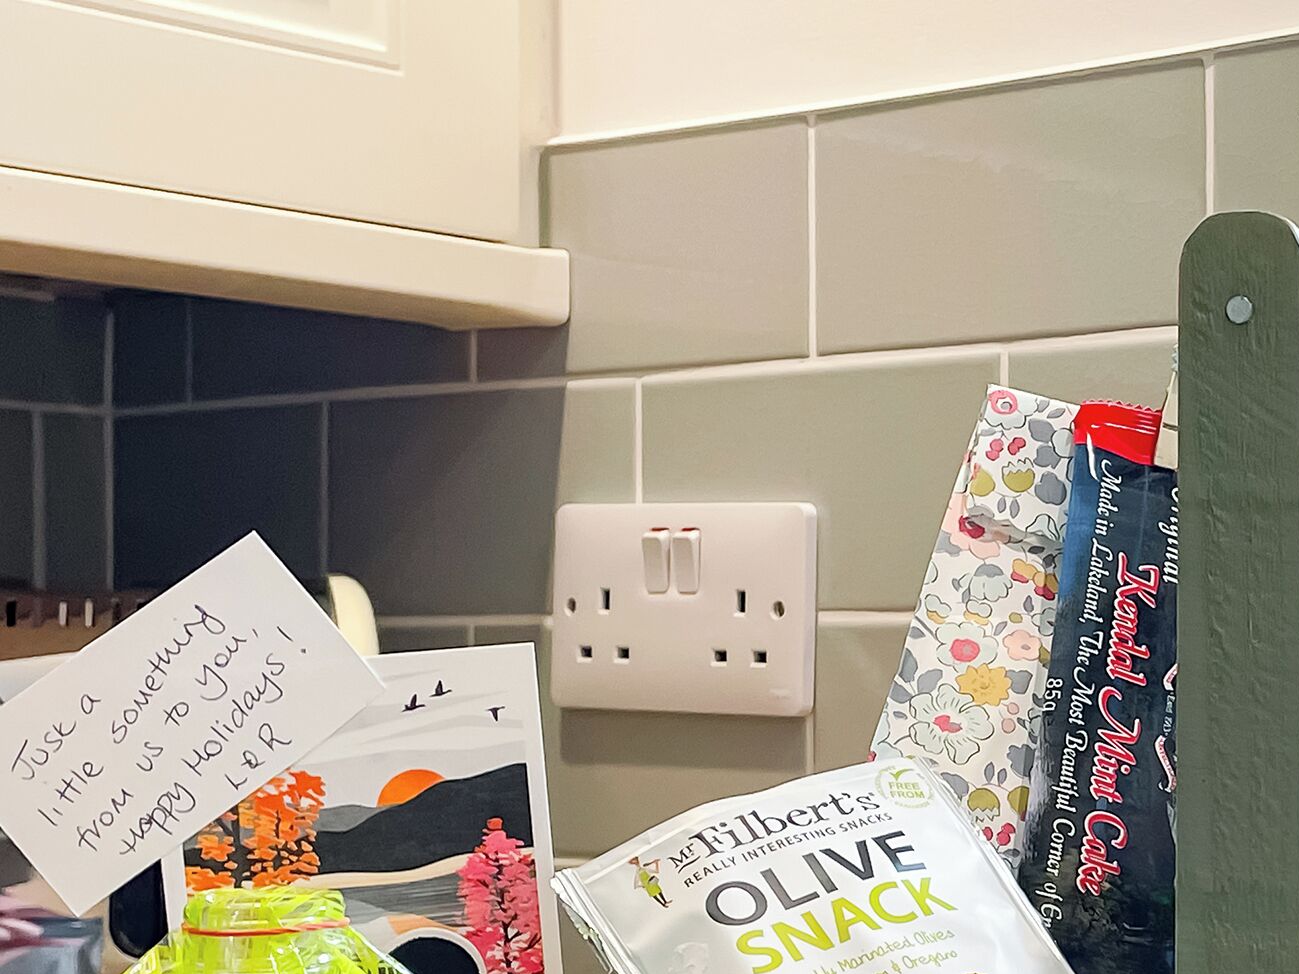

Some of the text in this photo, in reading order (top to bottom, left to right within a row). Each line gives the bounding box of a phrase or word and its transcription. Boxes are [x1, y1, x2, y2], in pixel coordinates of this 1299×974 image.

[1098, 459, 1122, 515] Made
[1095, 519, 1115, 542] in
[1079, 538, 1113, 624] Lakeland,
[1075, 630, 1103, 667] The
[38, 604, 226, 826] little something
[81, 693, 101, 714] a
[1069, 666, 1096, 725] Most
[1076, 552, 1160, 897] Kendal Mint Cake
[78, 789, 133, 851] from
[136, 742, 163, 772] us
[164, 702, 189, 726] to
[226, 774, 247, 790] L
[259, 723, 291, 751] R
[888, 782, 920, 790] FREE
[1050, 730, 1088, 813] Beautiful
[119, 783, 196, 856] Happy
[890, 791, 925, 799] FROM
[668, 792, 880, 873] Mr Filbert's
[684, 812, 893, 888] REALLY INTERESTING SNACKS
[1046, 818, 1075, 877] Corner
[706, 830, 927, 926] OLIVE
[1034, 882, 1064, 902] of
[736, 877, 958, 974] SNACK
[837, 940, 915, 972] Marinated
[914, 928, 955, 948] Olives
[901, 949, 958, 971] Oregano
